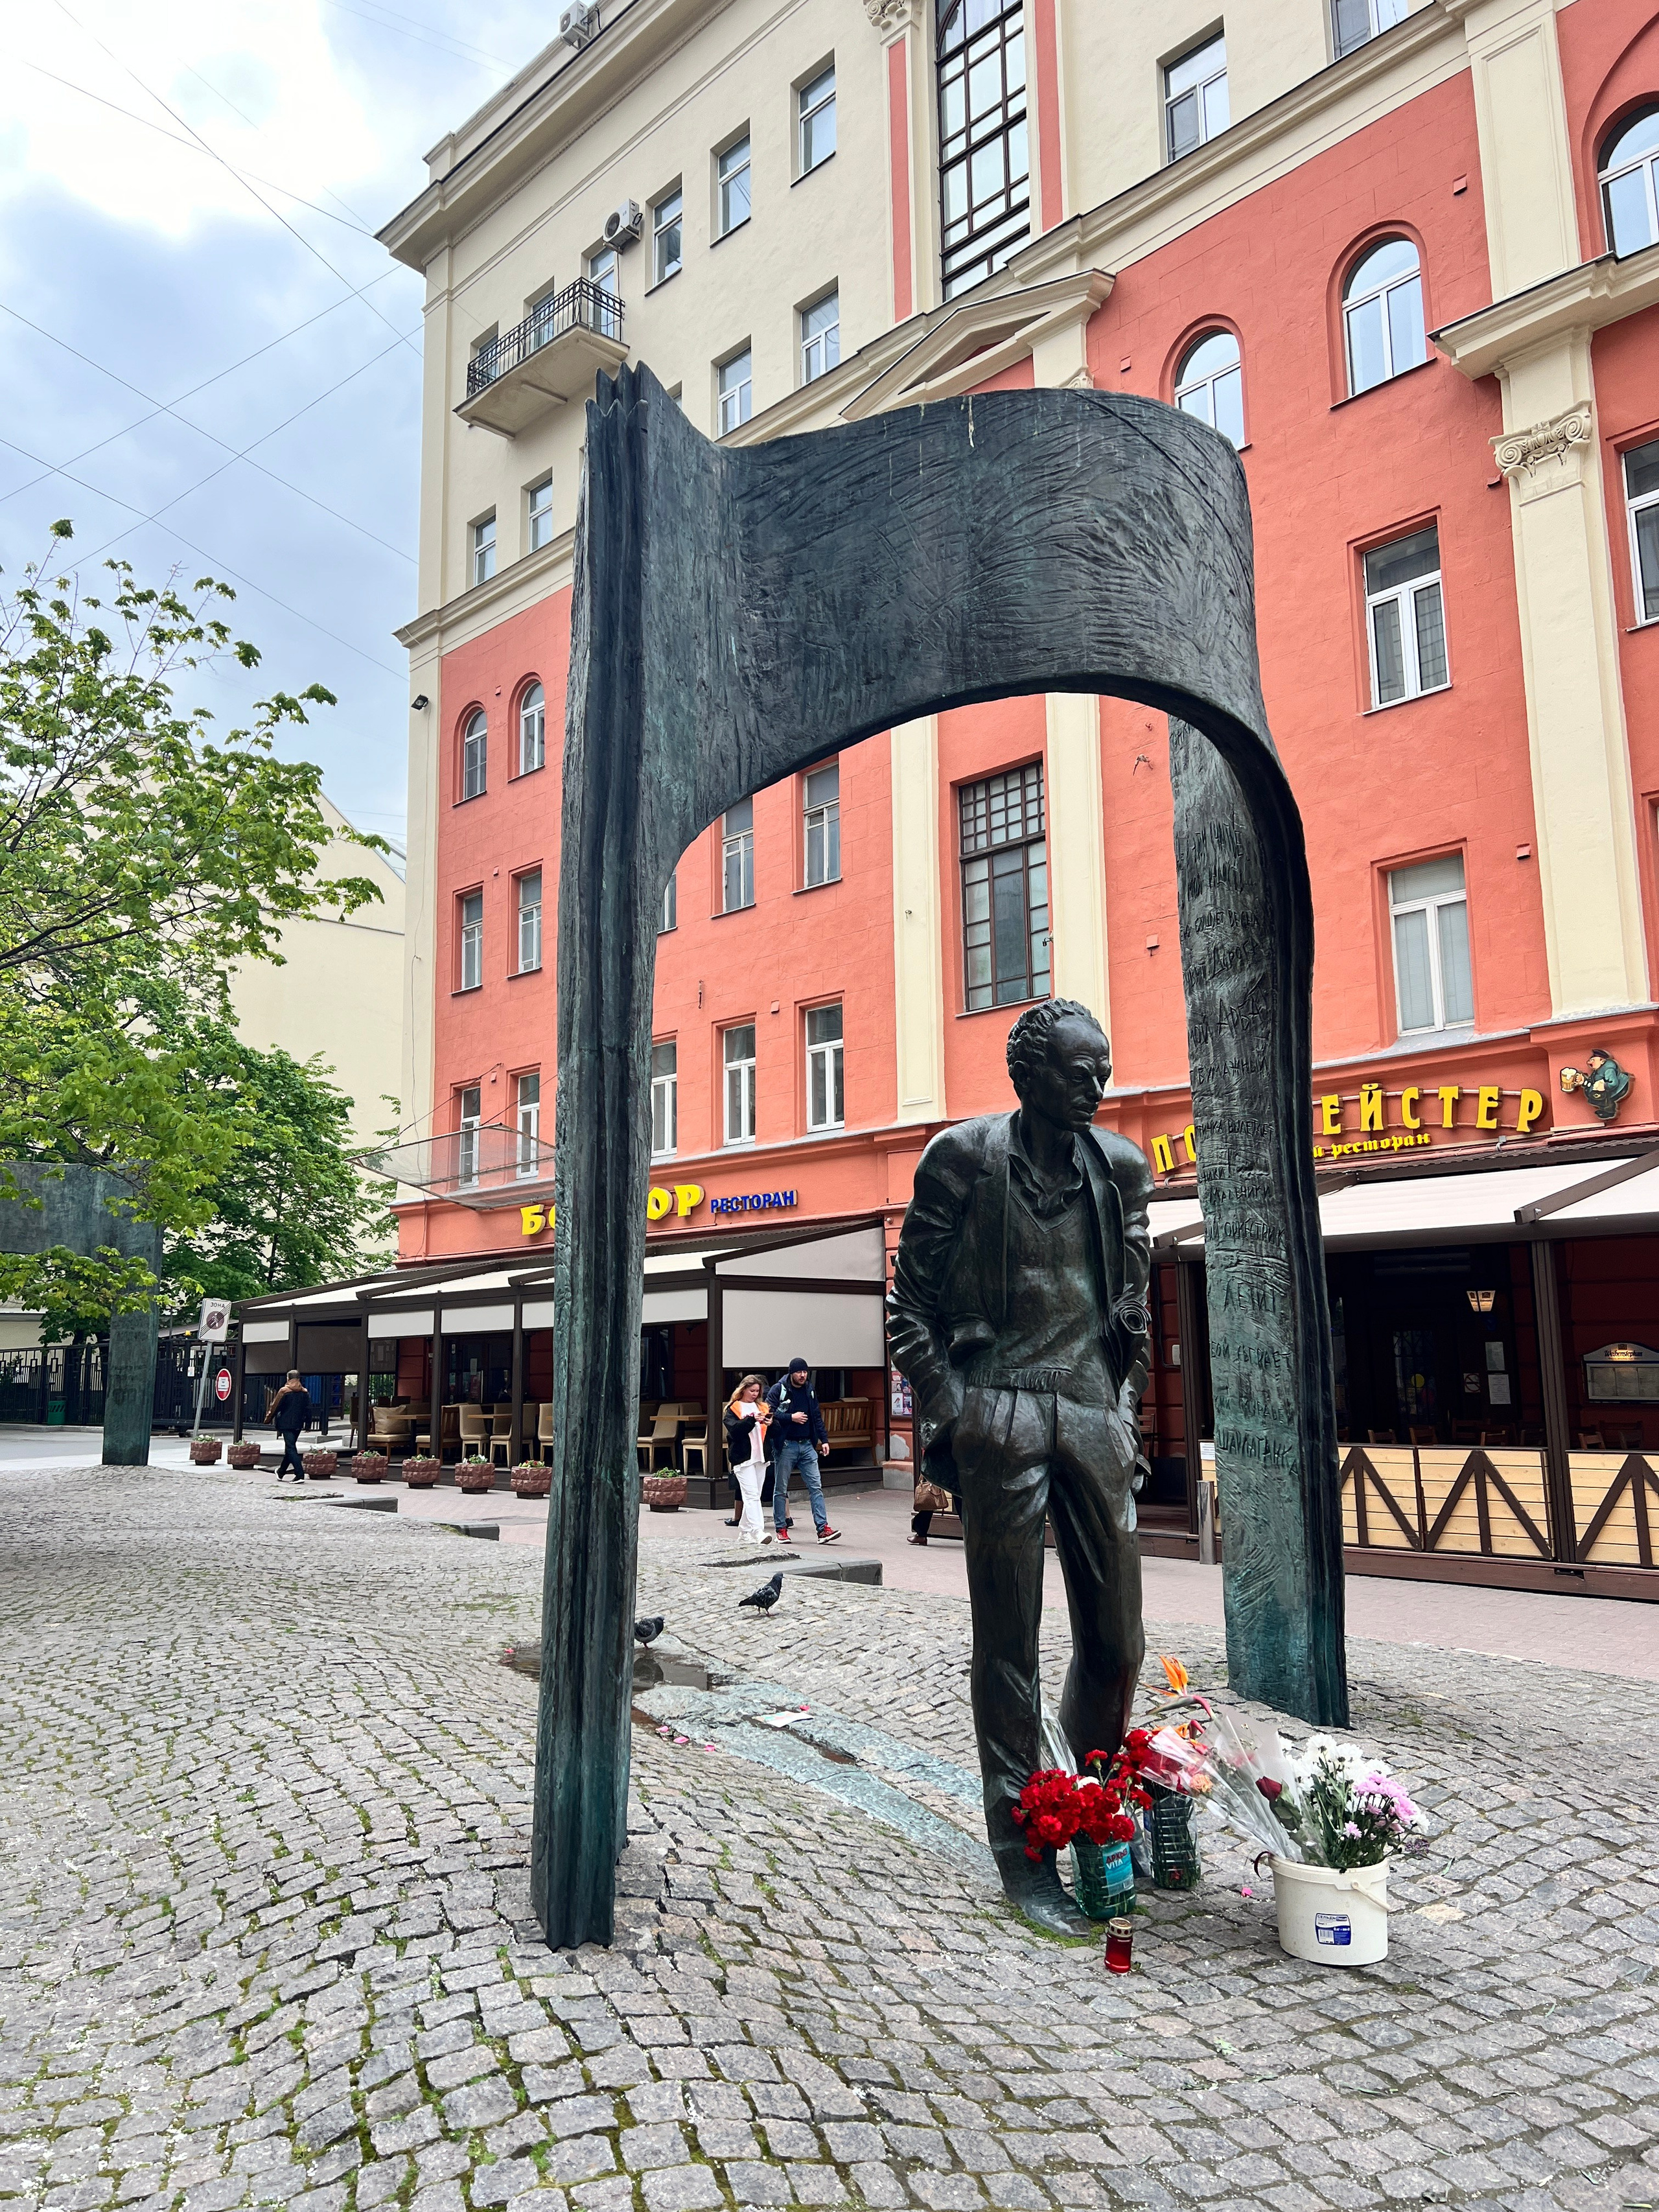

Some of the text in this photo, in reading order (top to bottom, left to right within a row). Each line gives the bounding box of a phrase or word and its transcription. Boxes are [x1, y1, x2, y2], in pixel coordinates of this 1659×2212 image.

[1331, 1133, 1432, 1159] ресторан
[711, 1189, 798, 1213] РЕСТОРАН
[1106, 1858, 1123, 1870] VITA
